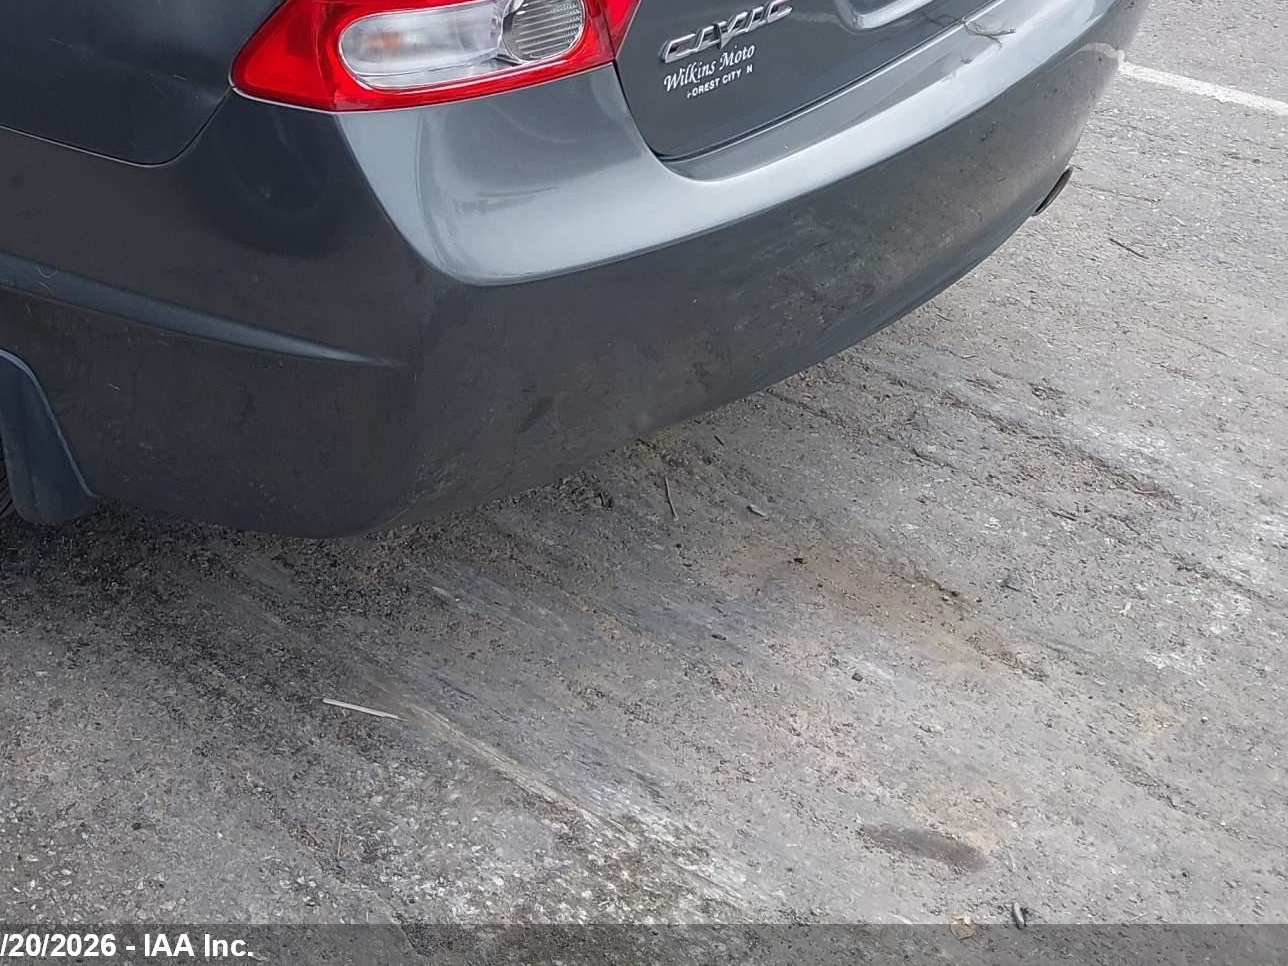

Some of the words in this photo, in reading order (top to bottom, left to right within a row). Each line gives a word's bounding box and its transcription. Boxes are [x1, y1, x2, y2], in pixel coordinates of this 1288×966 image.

[663, 61, 716, 92] Wilkins
[719, 44, 755, 71] Moto
[722, 68, 742, 84] CITY
